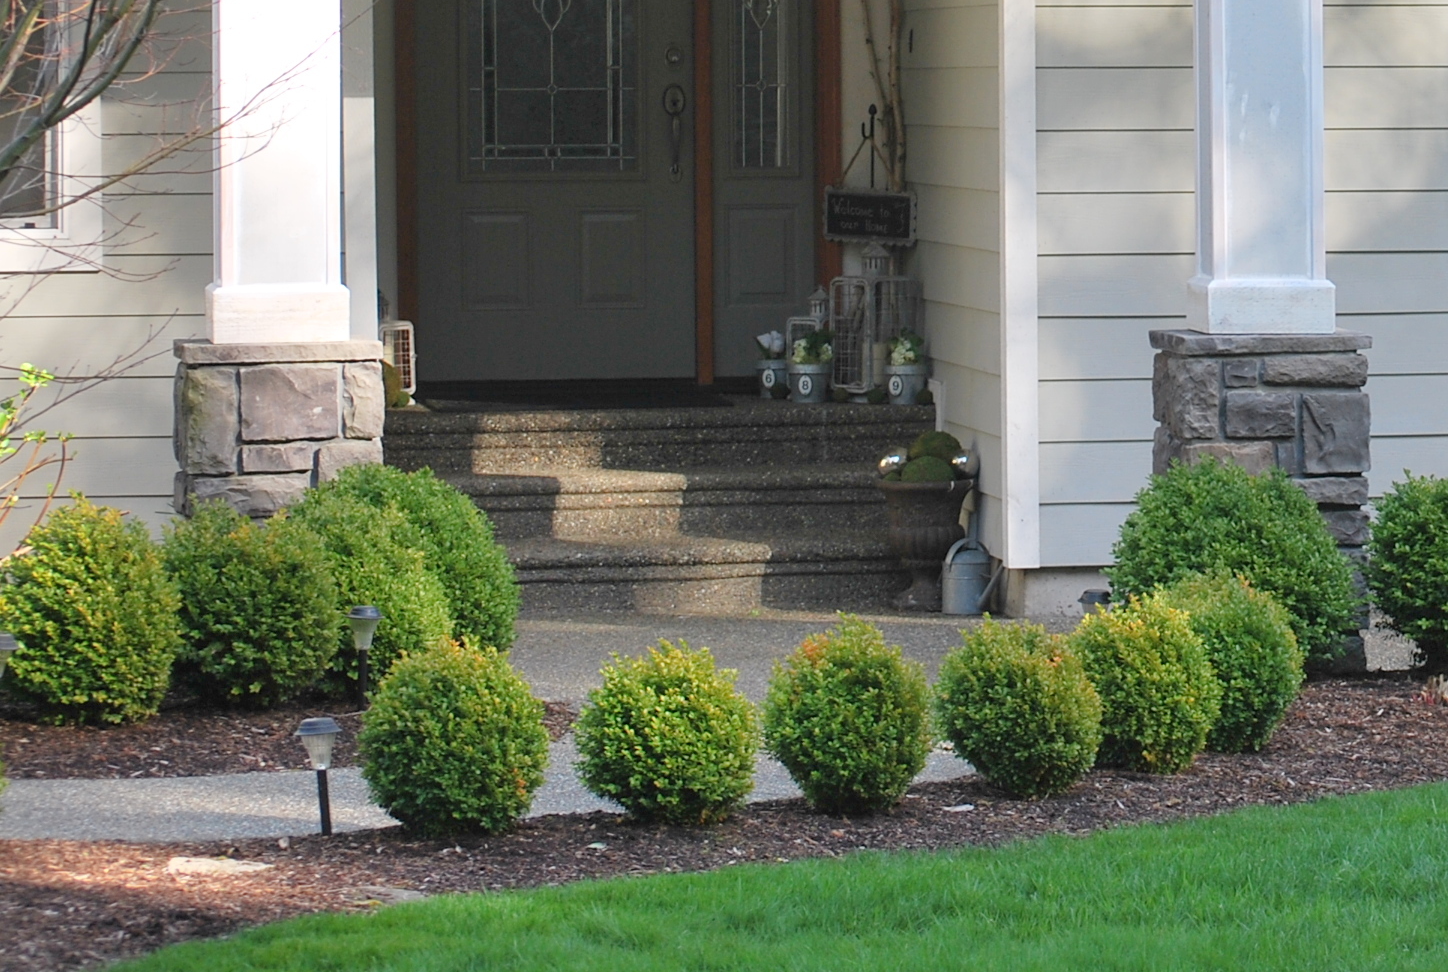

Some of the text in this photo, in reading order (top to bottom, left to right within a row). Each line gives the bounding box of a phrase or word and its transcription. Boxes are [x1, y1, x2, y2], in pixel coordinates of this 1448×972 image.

[831, 197, 890, 218] Welcome to
[840, 221, 858, 230] our
[766, 374, 772, 383] 6
[802, 380, 808, 390] 8
[892, 380, 899, 391] 9
